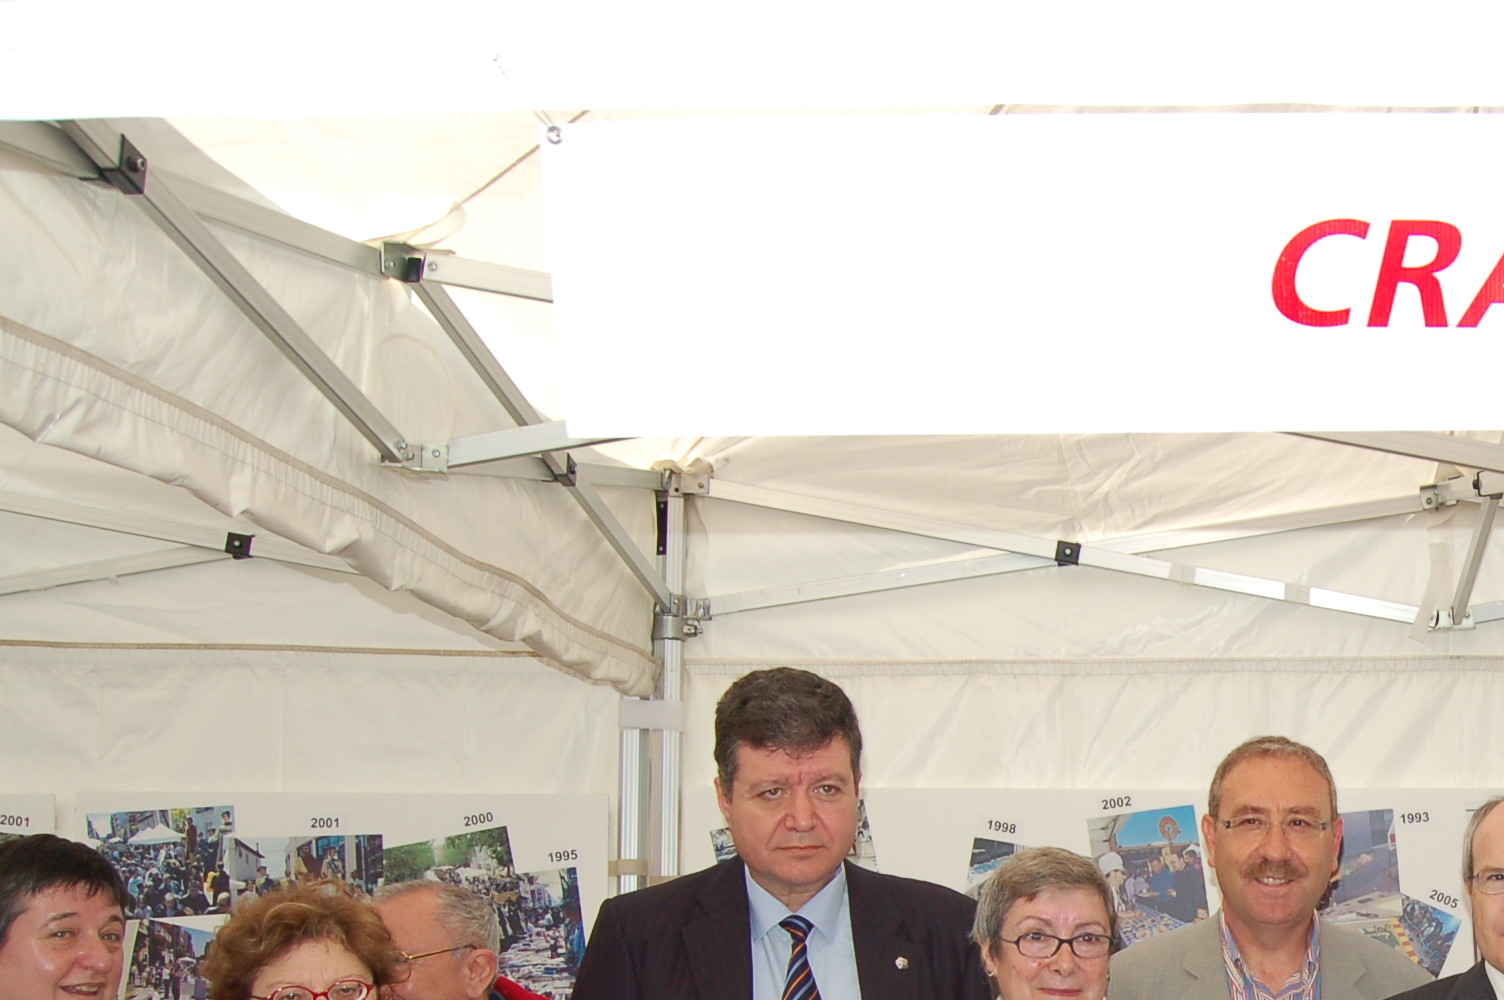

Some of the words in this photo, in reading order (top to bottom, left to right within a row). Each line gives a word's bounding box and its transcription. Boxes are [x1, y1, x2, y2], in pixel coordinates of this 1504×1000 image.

[1102, 796, 1132, 809] 2002
[0, 815, 30, 828] 2001
[310, 817, 340, 829] 2001
[463, 811, 494, 827] 2000
[1400, 812, 1430, 824] 1993
[987, 819, 1017, 834] 1998
[547, 849, 578, 862] 1995
[1429, 888, 1460, 911] 2005
